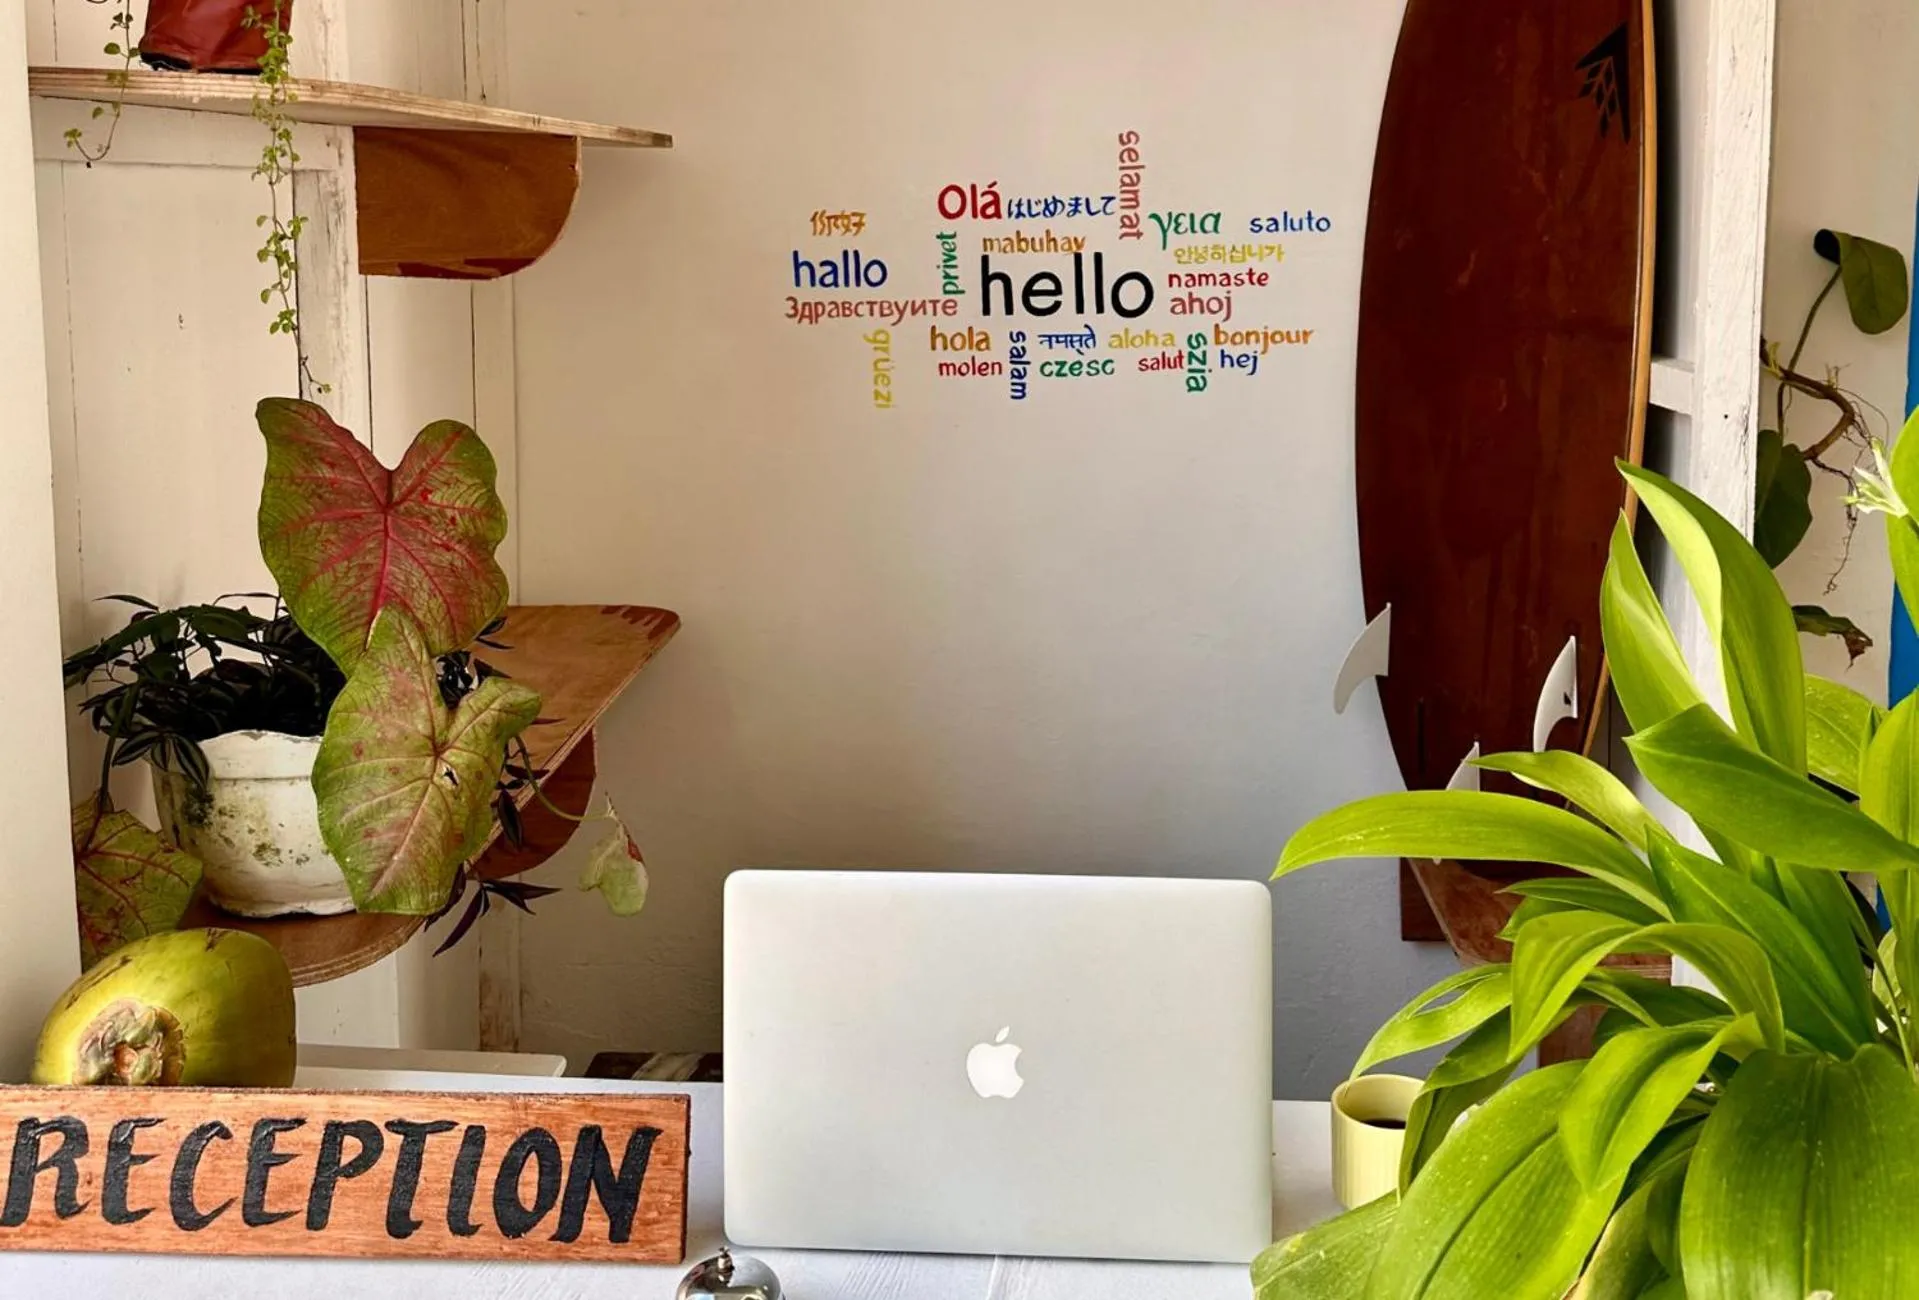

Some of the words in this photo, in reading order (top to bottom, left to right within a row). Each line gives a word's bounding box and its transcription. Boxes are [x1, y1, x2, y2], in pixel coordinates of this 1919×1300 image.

[937, 180, 1002, 220] Olá
[1118, 130, 1146, 240] selamat
[1007, 195, 1116, 218] はじめまして
[1249, 210, 1331, 234] saluto
[792, 249, 888, 288] hallo
[935, 231, 966, 295] privet
[1168, 267, 1269, 288] namaste
[981, 251, 1154, 319] hello
[1170, 290, 1232, 322] ahoj
[930, 325, 991, 352] hola
[1108, 327, 1176, 349] aloha
[1214, 323, 1314, 355] bonjour
[938, 355, 1003, 377] molen
[1009, 331, 1032, 400] salam
[1039, 358, 1115, 378] czesc
[1138, 350, 1184, 372] salut
[1185, 332, 1212, 393] szia
[1219, 349, 1259, 376] hej
[0, 1115, 662, 1243] RECEPTION
